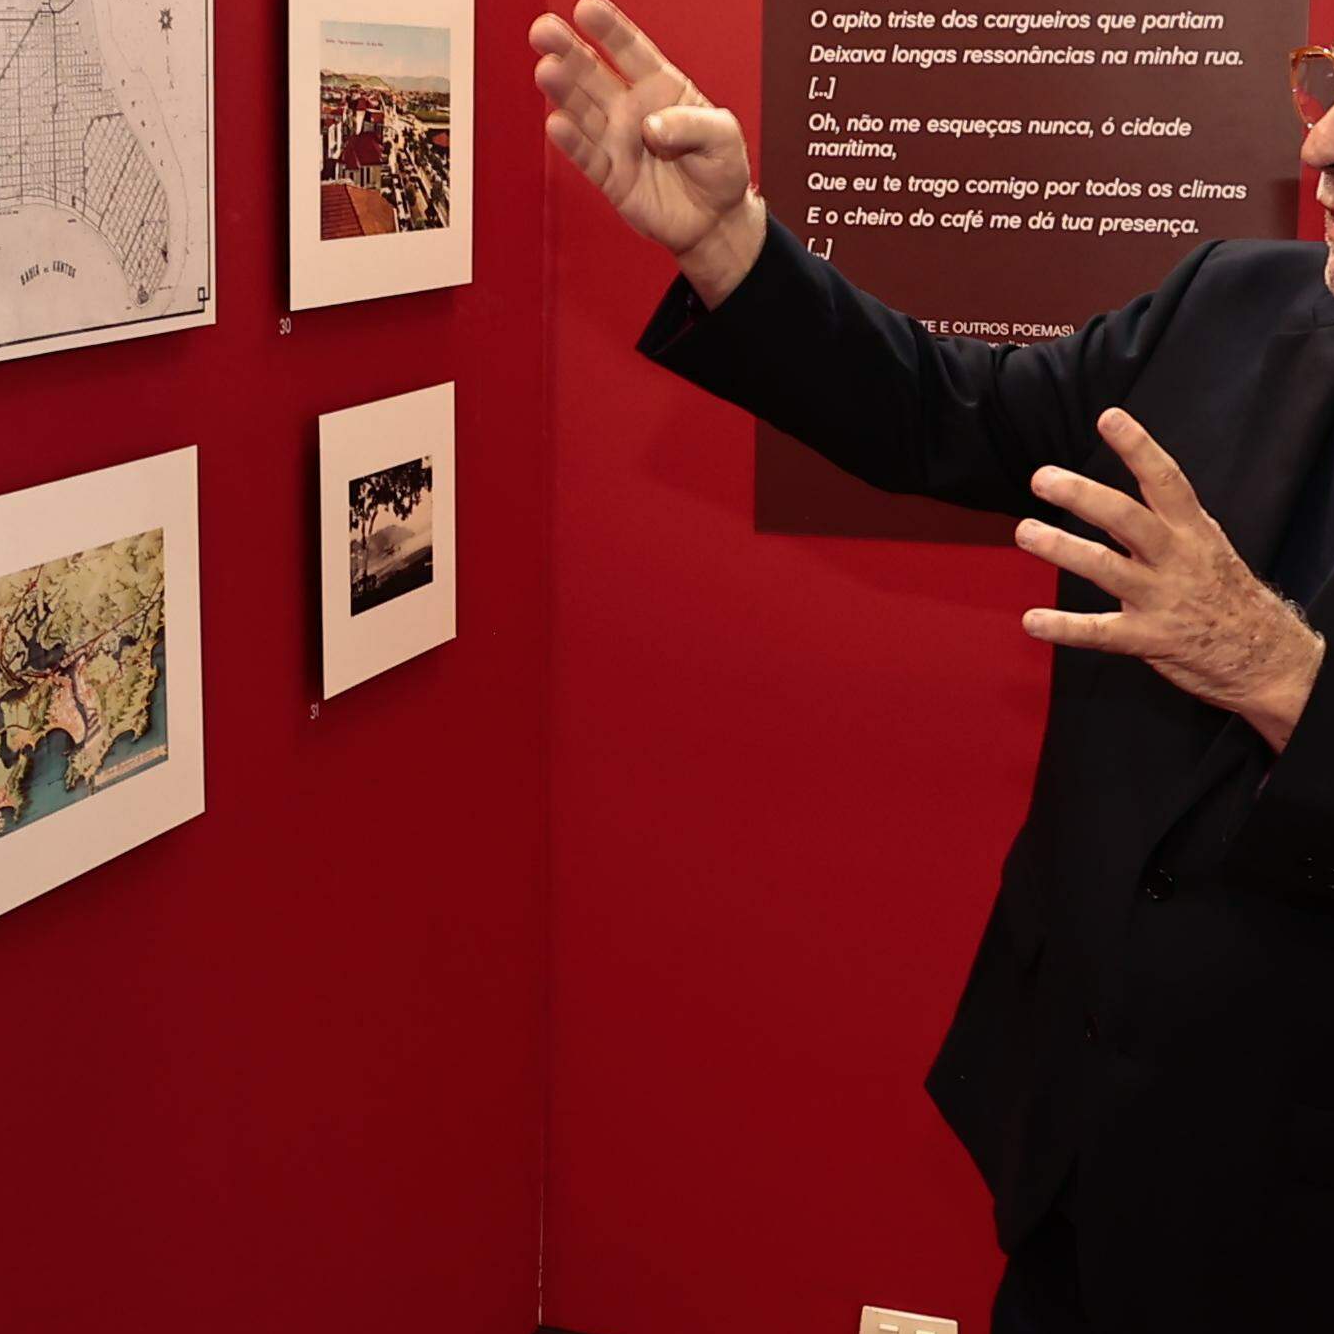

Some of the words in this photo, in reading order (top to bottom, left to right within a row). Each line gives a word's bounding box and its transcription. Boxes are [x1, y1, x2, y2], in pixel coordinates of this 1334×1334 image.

[810, 10, 827, 28] O
[832, 10, 882, 33] apito
[888, 10, 936, 29] triste
[941, 9, 978, 29] dos
[984, 10, 1091, 34] cargueiros
[1097, 14, 1136, 34] que
[1141, 11, 1224, 34] partiam
[810, 45, 887, 63] Deixava
[891, 44, 957, 69] longas
[962, 45, 1095, 64] ressonâncias
[1101, 50, 1128, 65] na
[1134, 45, 1199, 65] minha
[1204, 51, 1243, 65] rua.
[808, 113, 840, 135] Oh,
[846, 114, 884, 132] não
[889, 118, 921, 133] me
[927, 118, 1022, 139] esqueças
[1027, 120, 1094, 138] nunca,
[1101, 116, 1115, 135] ó
[1121, 116, 1192, 137] cidade
[807, 138, 897, 161] marítima,
[807, 172, 847, 191] Que
[853, 177, 877, 191] eu
[883, 175, 902, 192] te
[908, 175, 960, 198] trago
[965, 176, 1039, 200] comigo
[1044, 181, 1081, 200] por
[1086, 177, 1142, 197] todos
[1148, 183, 1173, 197] os
[1179, 179, 1247, 199] climas
[807, 206, 821, 224] E
[825, 211, 839, 225] o
[844, 206, 903, 226] cheiro
[909, 208, 935, 227] do
[940, 209, 984, 233] café
[989, 214, 1022, 229] me
[1028, 211, 1055, 230] dá
[1061, 213, 1094, 231] tua
[1098, 217, 1199, 238] presença.
[279, 316, 292, 336] 30
[917, 320, 936, 333] TE
[940, 320, 949, 334] E
[952, 321, 1009, 336] OUTROS
